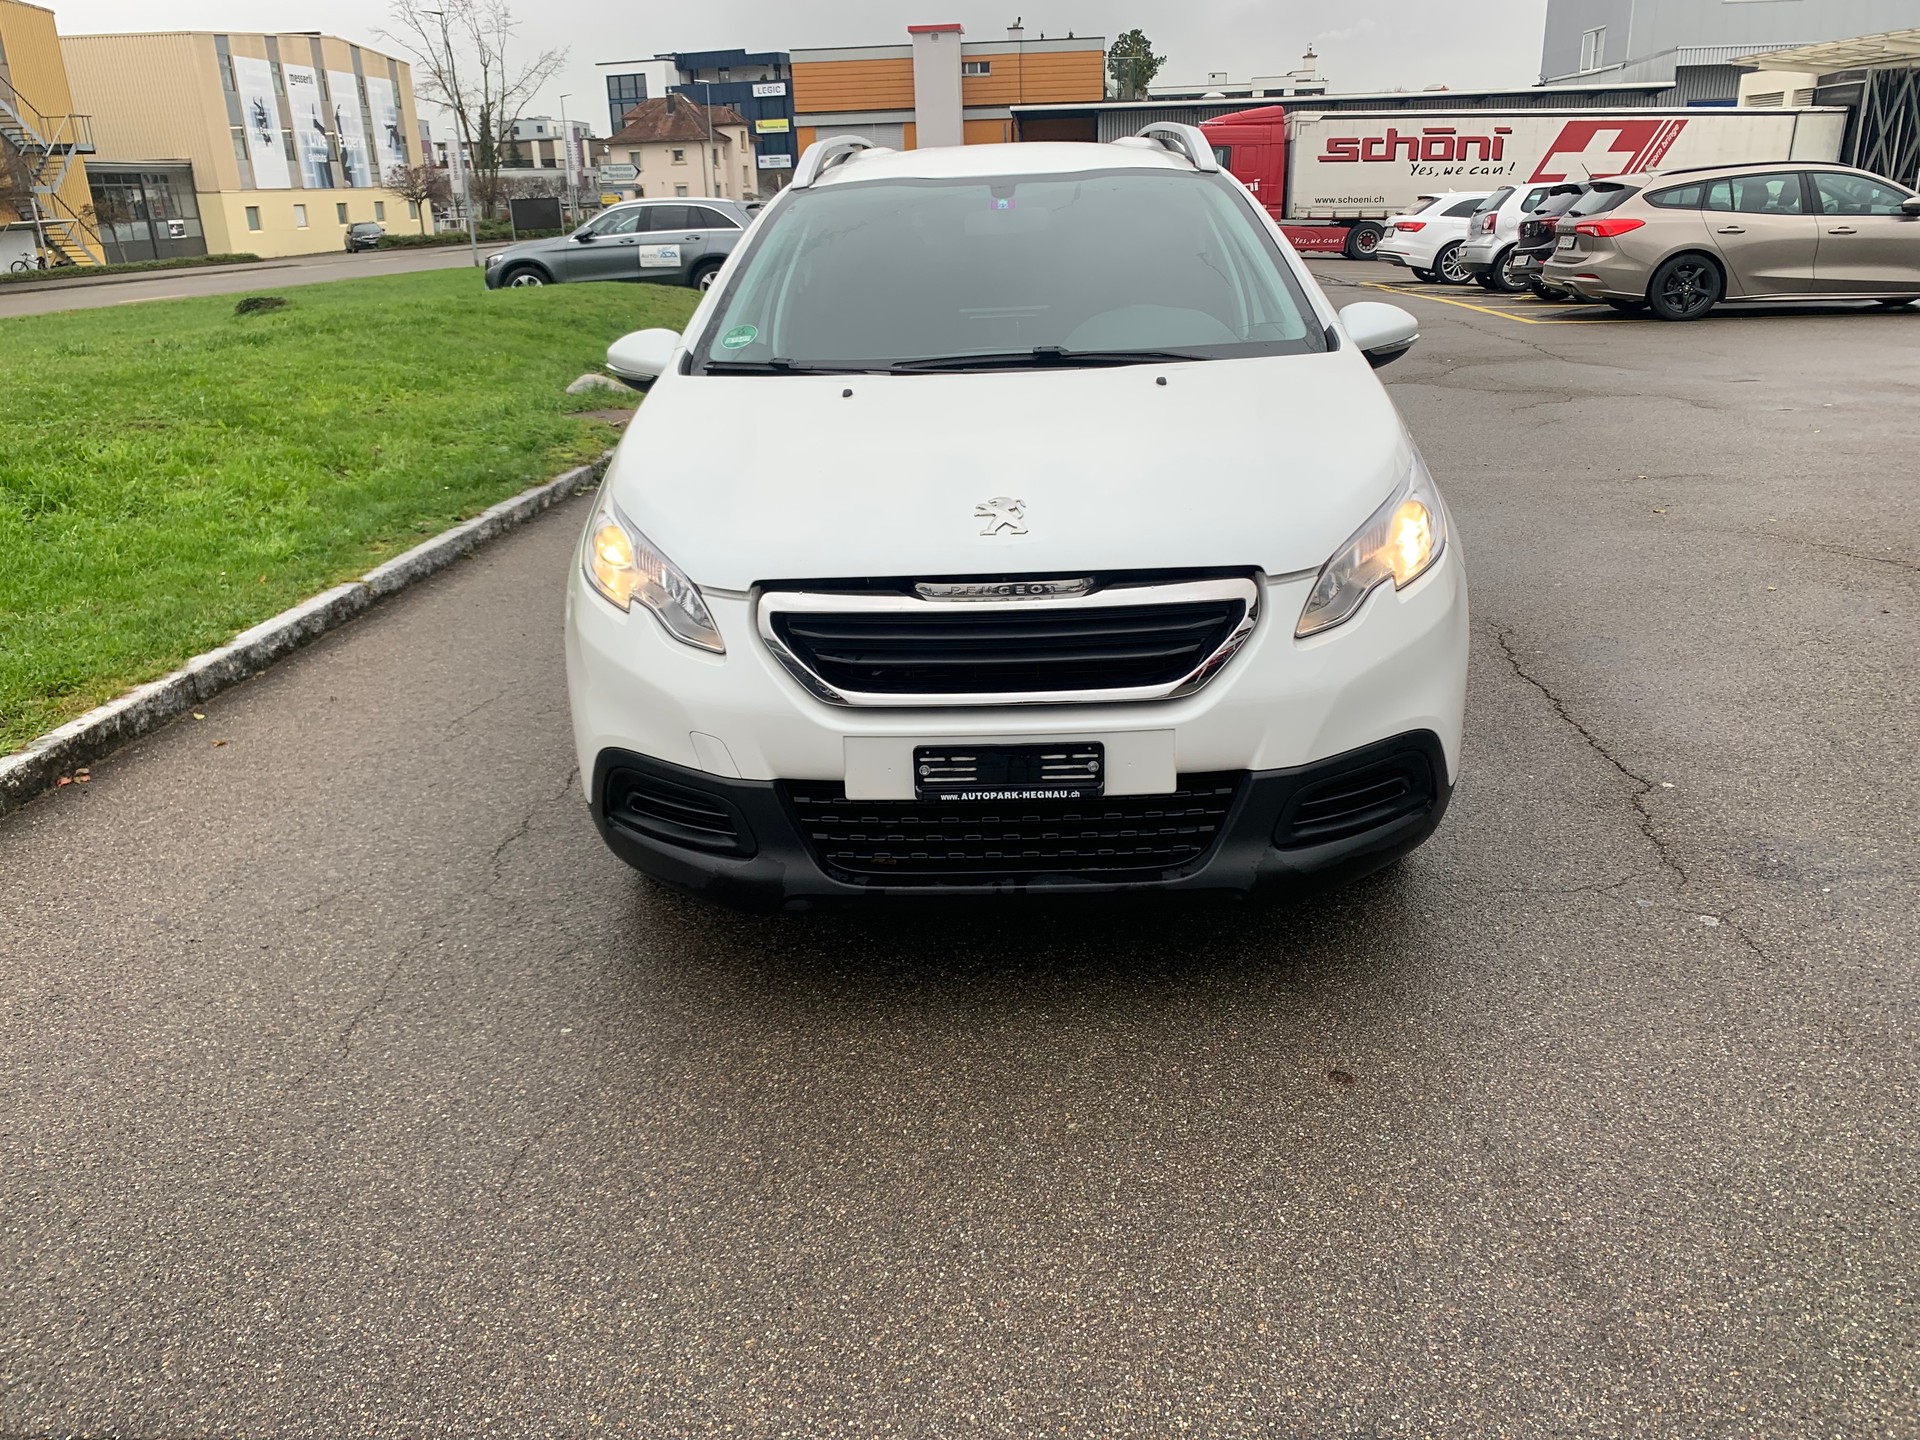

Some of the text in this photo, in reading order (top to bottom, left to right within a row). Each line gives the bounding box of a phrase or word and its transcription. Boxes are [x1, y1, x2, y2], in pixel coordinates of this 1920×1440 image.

[757, 85, 781, 95] LEGIC
[1661, 124, 1680, 149] bringe
[1410, 163, 1440, 177] Yes,
[1443, 166, 1463, 176] we
[1314, 195, 1385, 204] www.schoeni.ch
[951, 584, 1057, 595] PEUGEOT
